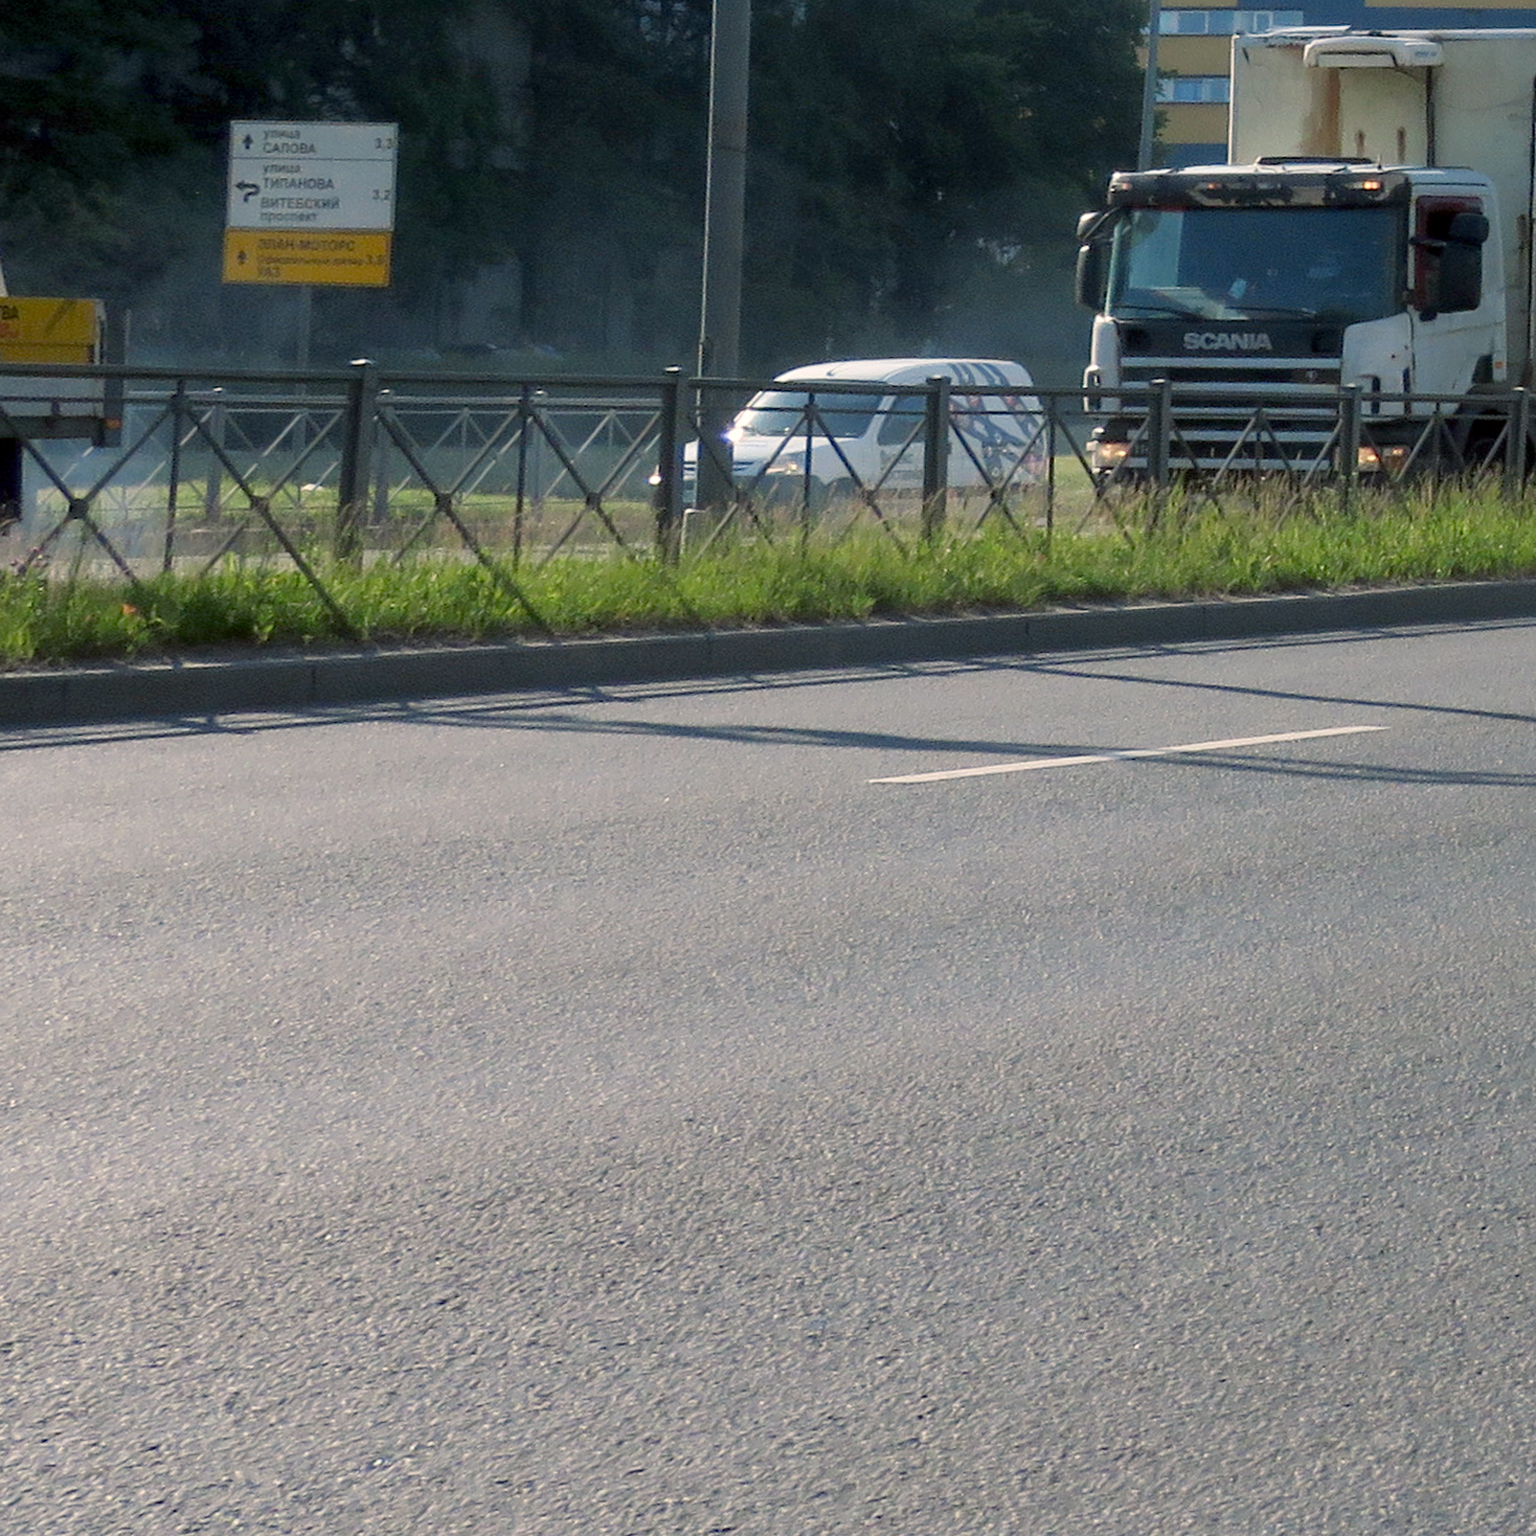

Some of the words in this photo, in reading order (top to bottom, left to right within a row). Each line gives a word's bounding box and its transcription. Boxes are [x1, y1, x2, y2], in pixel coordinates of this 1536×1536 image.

[263, 130, 301, 140] улица
[263, 142, 317, 154] САЛОВА
[263, 164, 301, 174] улица
[263, 177, 335, 190] ТИПАНОВА
[260, 196, 341, 210] ВИТЕБСКИЙ
[259, 211, 317, 223] проспект
[1183, 332, 1273, 351] SCANIA
